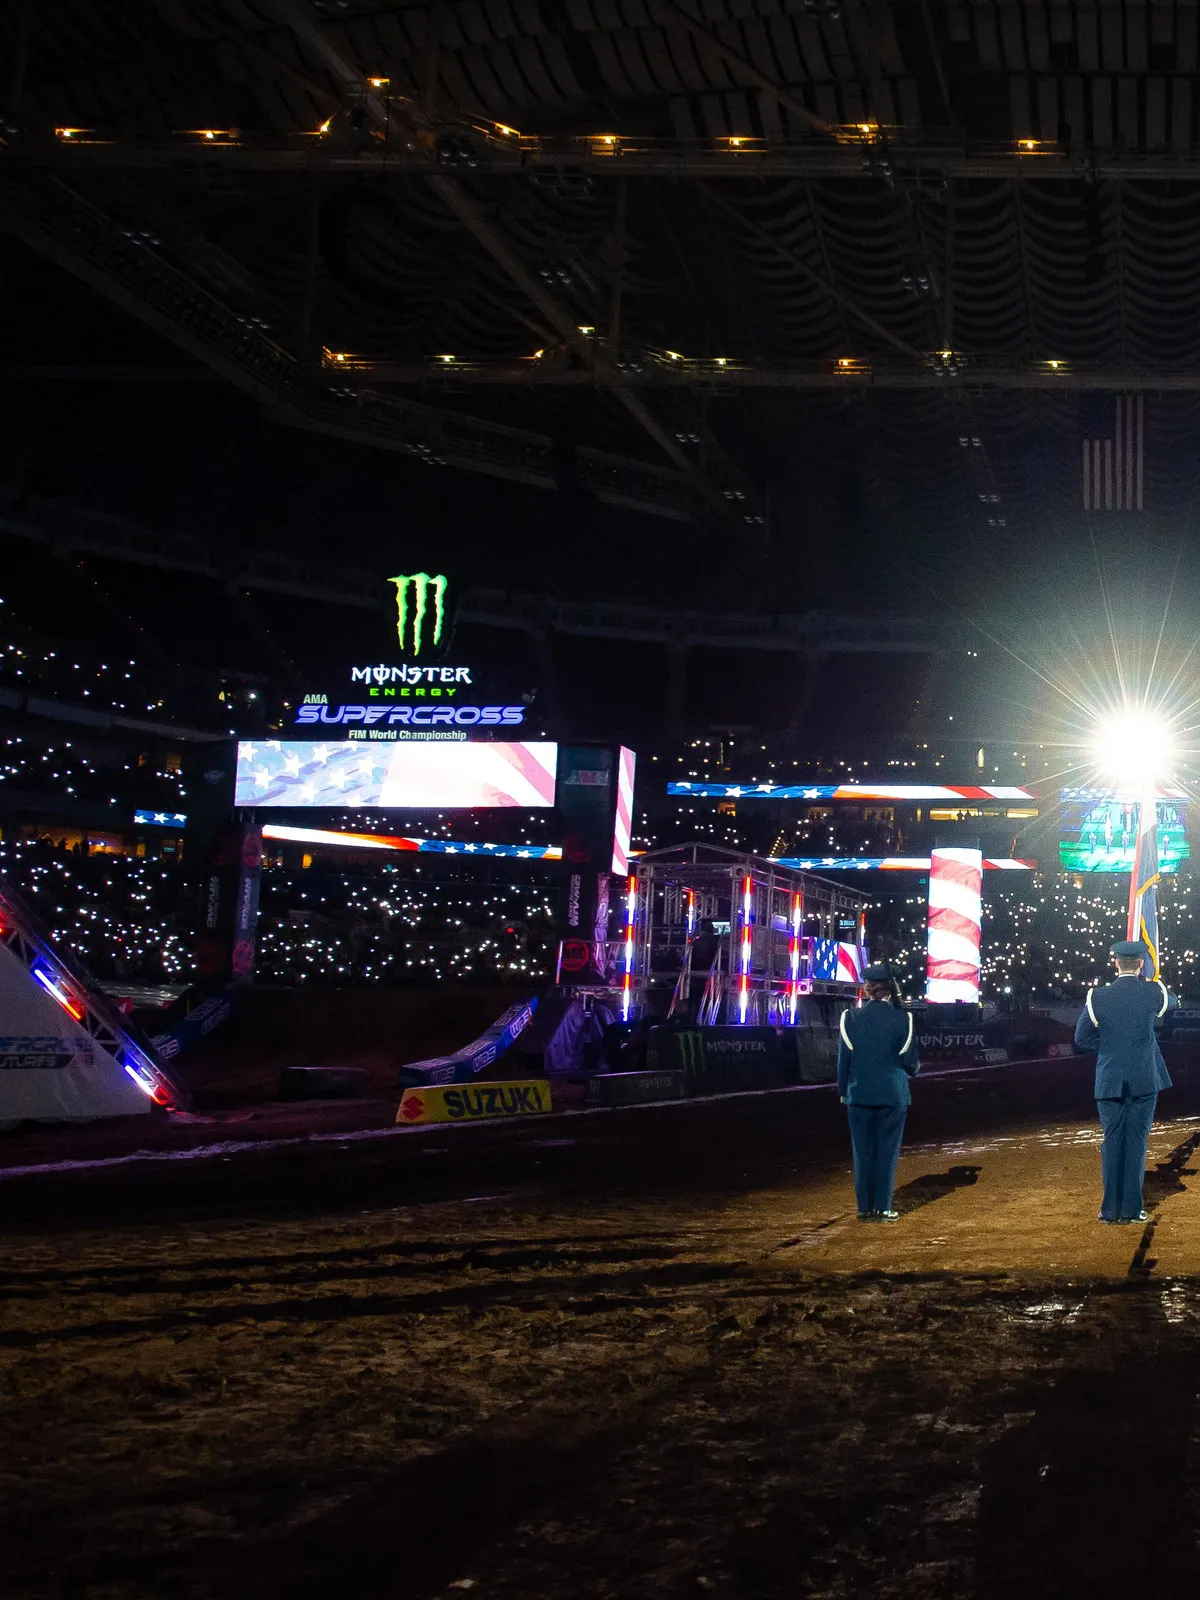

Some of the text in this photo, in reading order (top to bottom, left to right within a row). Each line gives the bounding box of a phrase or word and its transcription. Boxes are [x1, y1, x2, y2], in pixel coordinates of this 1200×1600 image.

[351, 663, 472, 685] MONSTER
[303, 694, 328, 704] AMA
[369, 688, 457, 697] ENERGY
[294, 705, 527, 725] SUPERCROSS
[348, 730, 467, 742] FIM World Championship
[915, 1033, 986, 1049] ONSTER
[443, 1087, 544, 1118] SUZUKI
